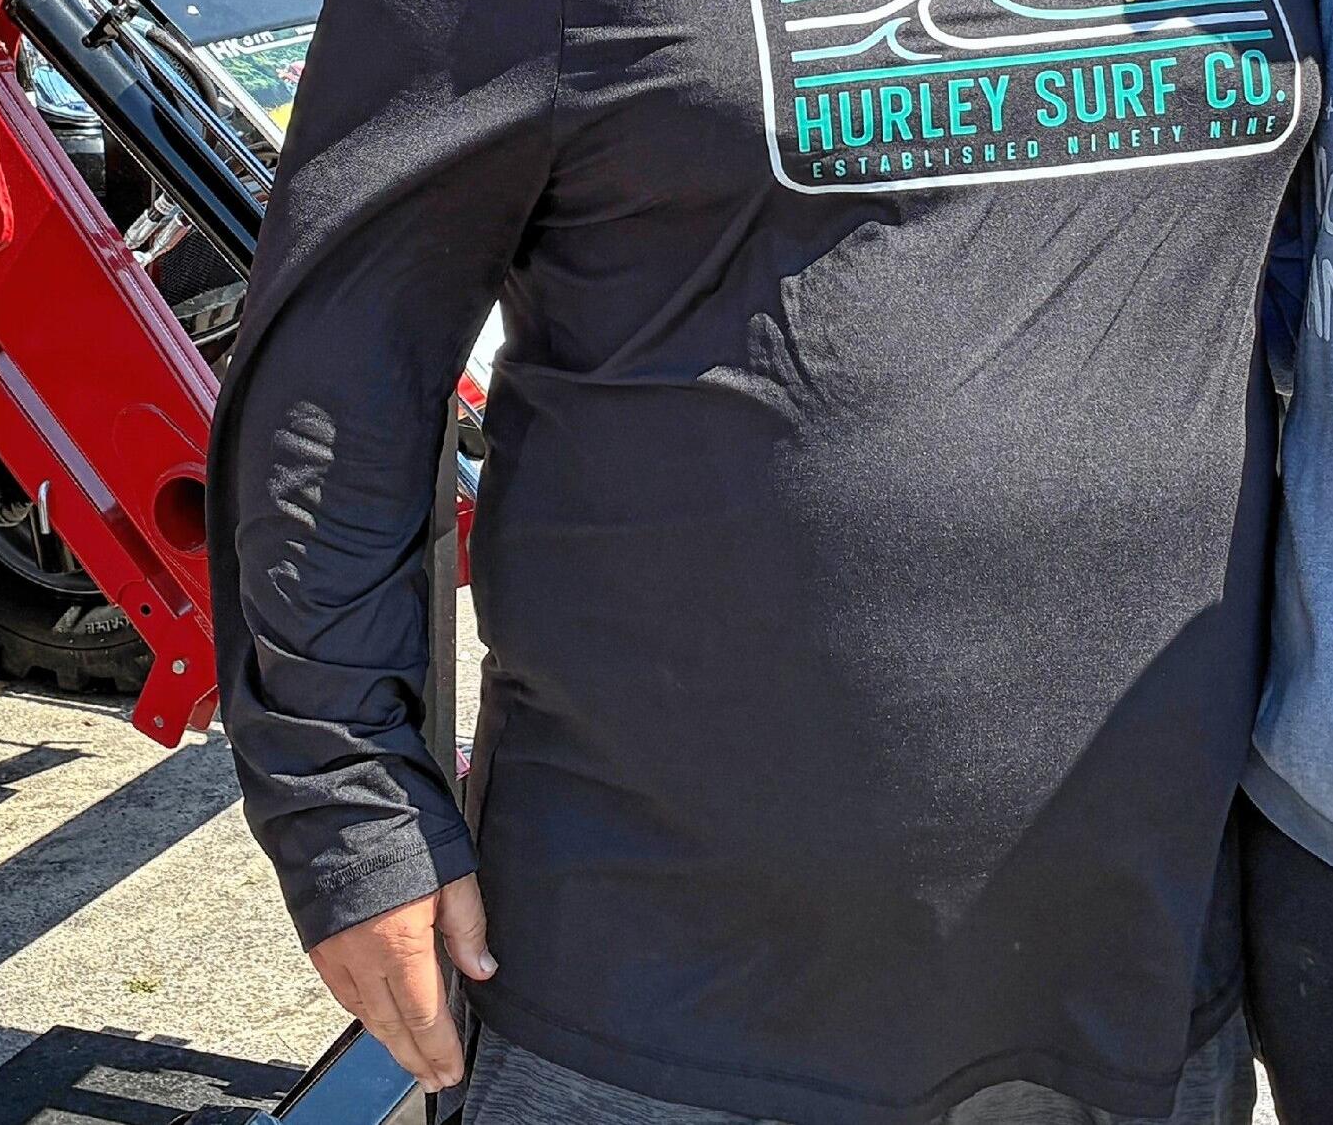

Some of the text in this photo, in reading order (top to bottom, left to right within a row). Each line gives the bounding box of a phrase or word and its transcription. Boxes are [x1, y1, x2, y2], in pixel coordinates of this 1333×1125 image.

[794, 49, 1287, 153] HURLEY SURF CO.
[812, 115, 1277, 179] ESTABLISHED NINETY NINE
